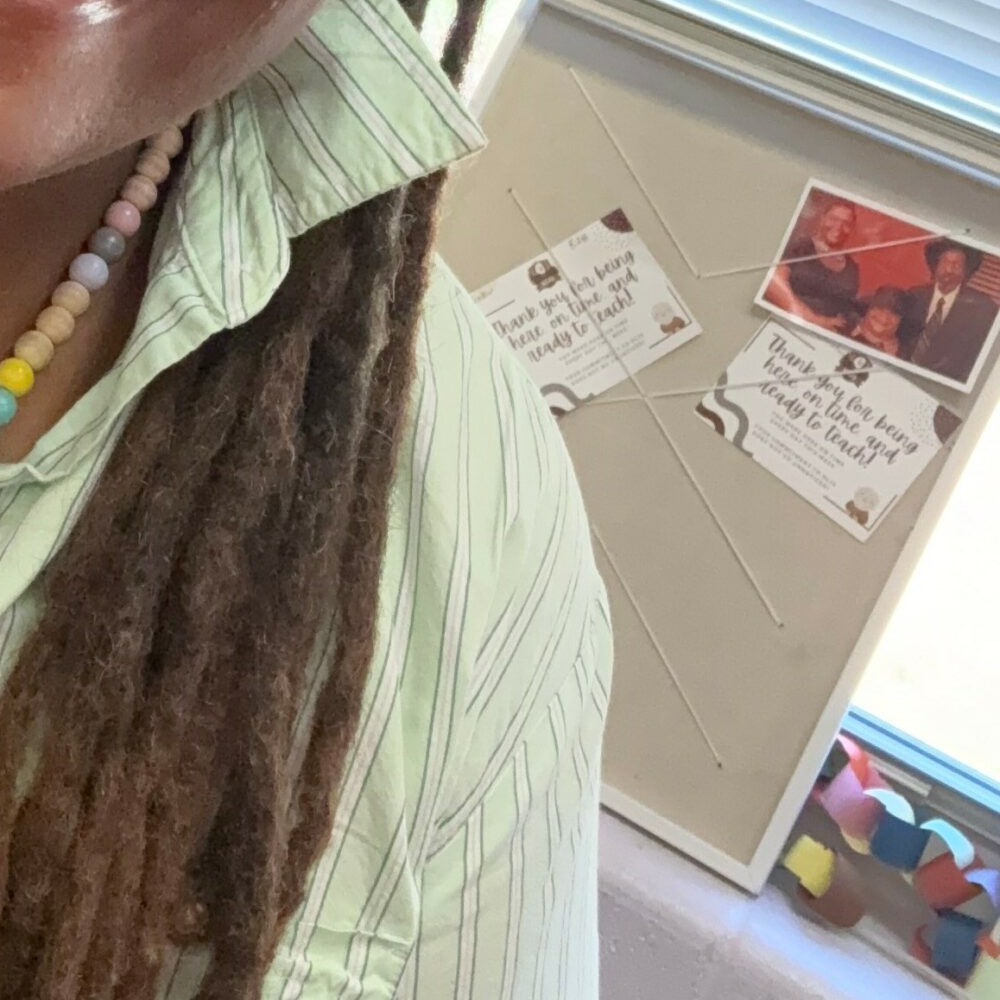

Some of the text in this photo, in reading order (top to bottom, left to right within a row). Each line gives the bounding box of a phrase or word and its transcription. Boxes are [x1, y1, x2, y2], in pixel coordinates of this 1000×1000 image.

[491, 251, 635, 337] Thank you for being
[508, 324, 544, 350] here
[550, 313, 571, 329] on
[567, 292, 601, 317] time
[608, 267, 638, 296] and
[527, 331, 573, 362] ready
[571, 321, 588, 338] to
[591, 290, 635, 326] each!
[763, 356, 801, 388] here
[803, 390, 823, 408] on
[825, 401, 860, 433] time
[864, 436, 900, 465] and
[768, 334, 816, 374] Thank
[814, 375, 846, 403] you
[846, 396, 875, 422] for
[874, 414, 919, 455] being
[806, 411, 823, 429] to
[824, 425, 877, 468] teach!
